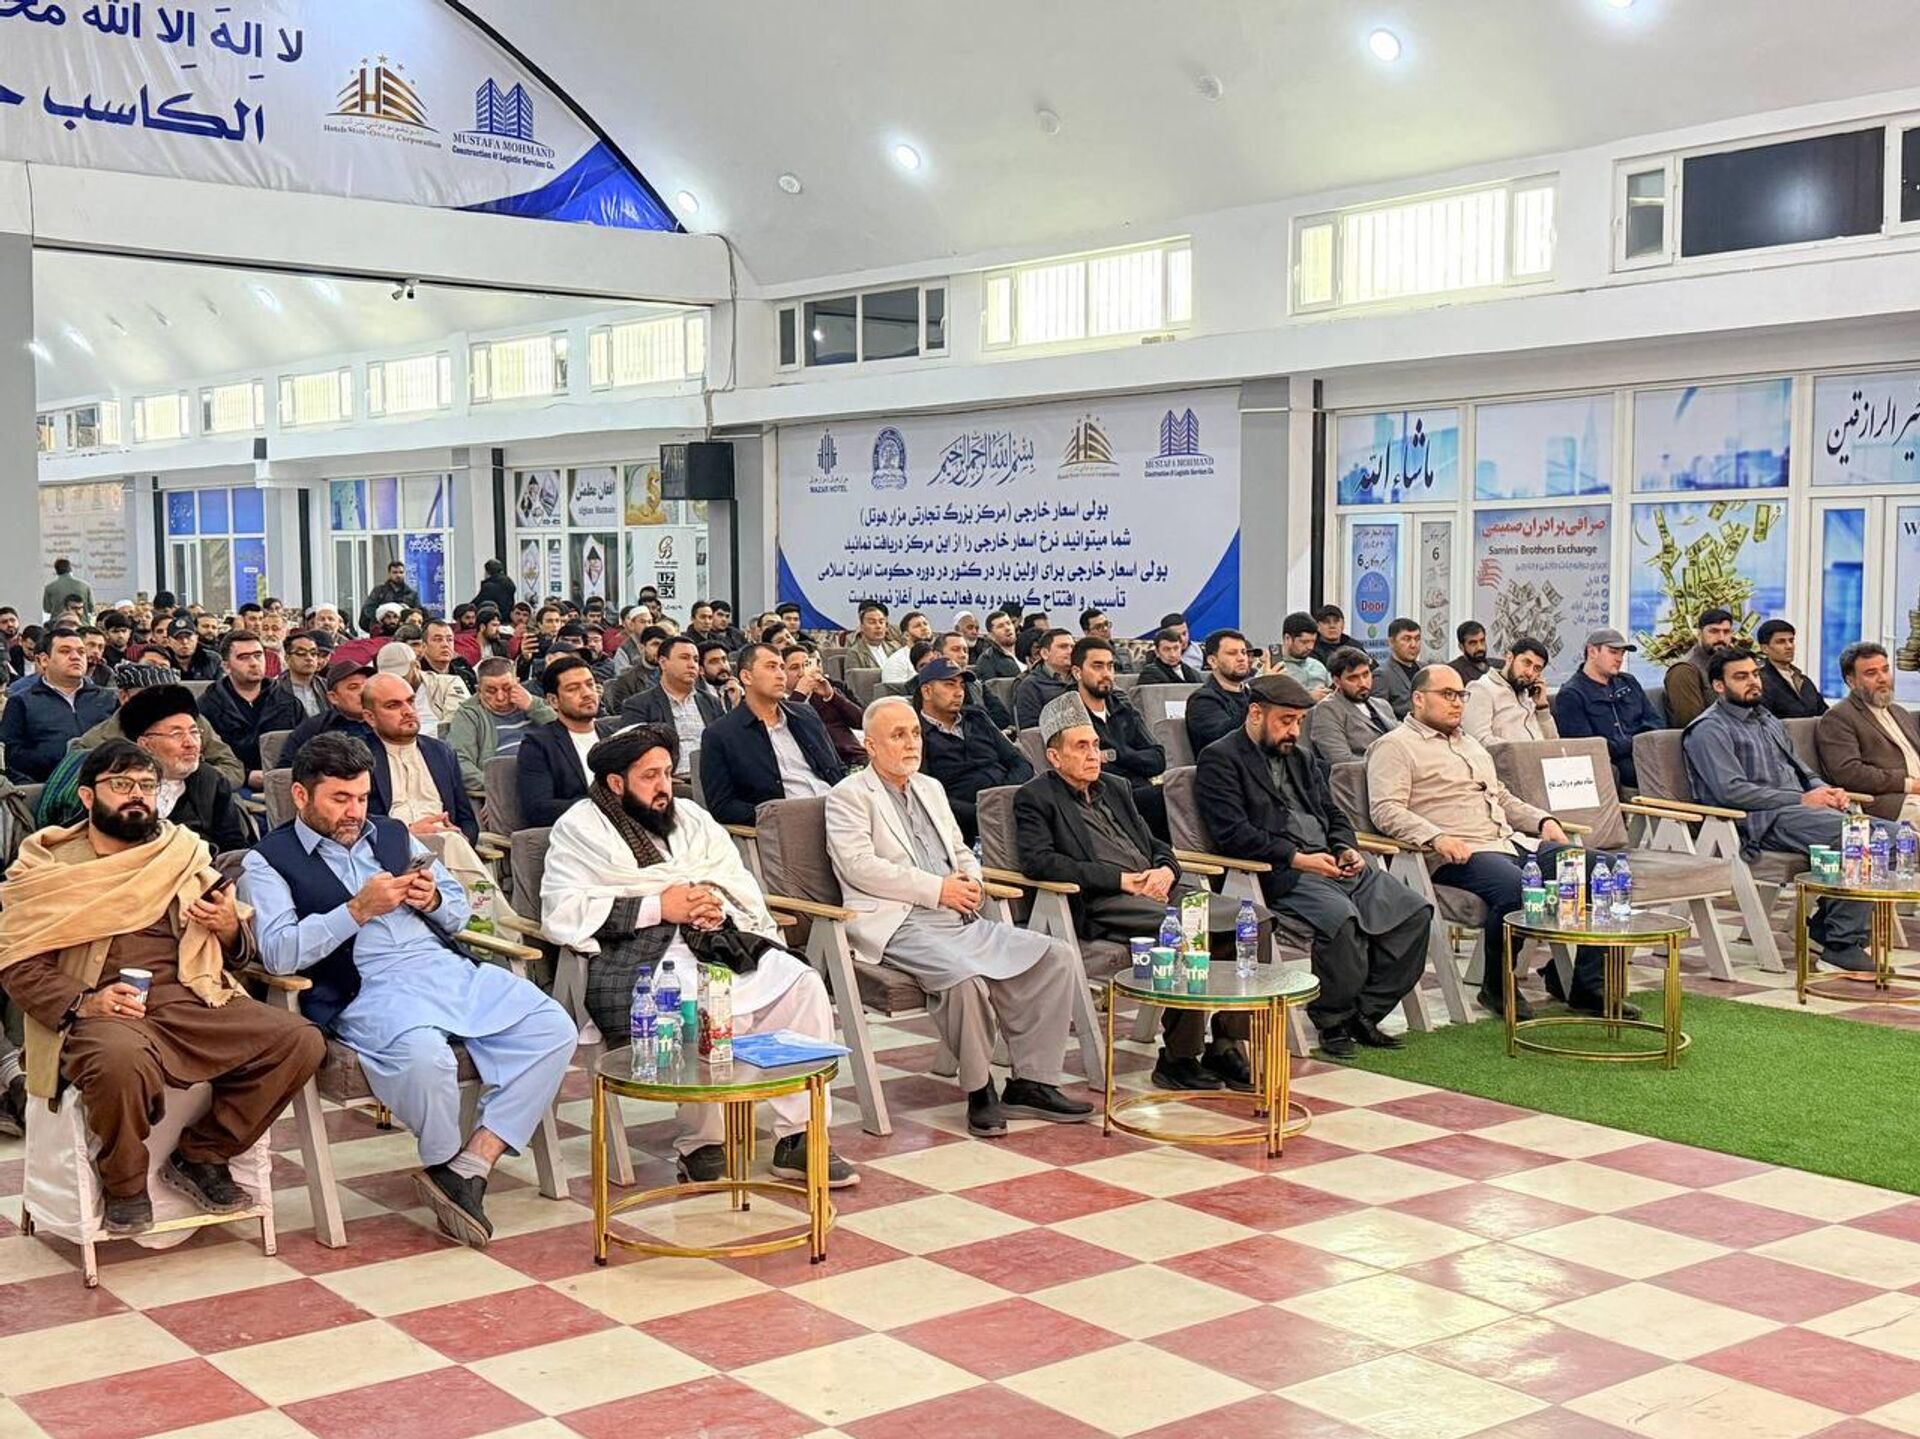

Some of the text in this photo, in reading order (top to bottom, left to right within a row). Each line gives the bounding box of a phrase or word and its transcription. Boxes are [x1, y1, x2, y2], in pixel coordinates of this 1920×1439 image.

[277, 27, 303, 63] لا
[396, 134, 442, 148] Corporation
[452, 131, 555, 159] MUSTAFA MOHMAND
[452, 144, 491, 160] Construction
[499, 152, 520, 164] Logistic
[522, 156, 546, 169] Services
[889, 507, 906, 526] مزار
[908, 505, 941, 526] تجارتی
[942, 503, 973, 524] بزرگ
[1014, 501, 1050, 523] خارجی
[1052, 501, 1079, 521] اسعار
[1082, 500, 1108, 521] بولی
[1481, 516, 1606, 538] صرافی برادران صمیمی
[873, 534, 904, 553] دریافت
[905, 534, 934, 553] مرکز
[936, 535, 950, 553] این
[952, 531, 963, 552] از
[964, 535, 973, 552] را
[974, 532, 1009, 553] خارجی
[1011, 532, 1037, 551] اسعار
[1040, 531, 1059, 553] نرخ
[1110, 528, 1132, 547] شما
[1432, 546, 1440, 561] 6
[1489, 544, 1598, 556] Samimi Brothers Exchange
[1357, 554, 1364, 567] 6
[660, 572, 674, 584] UZ
[817, 562, 846, 581] اسلامی
[847, 562, 873, 580] امارات
[874, 562, 914, 581] حکومت
[937, 567, 947, 581] در
[949, 561, 982, 581] کشور
[983, 567, 995, 581] در
[995, 562, 1011, 582] بار
[1013, 562, 1039, 581] اولین
[1041, 563, 1065, 582] برای
[1067, 561, 1106, 582] خارجی
[1108, 561, 1137, 581] اسعار
[1140, 560, 1168, 582] بولی
[660, 586, 674, 597] EX
[940, 588, 973, 606] فعالیت
[1043, 590, 1076, 612] افتتاح
[1079, 596, 1085, 612] و
